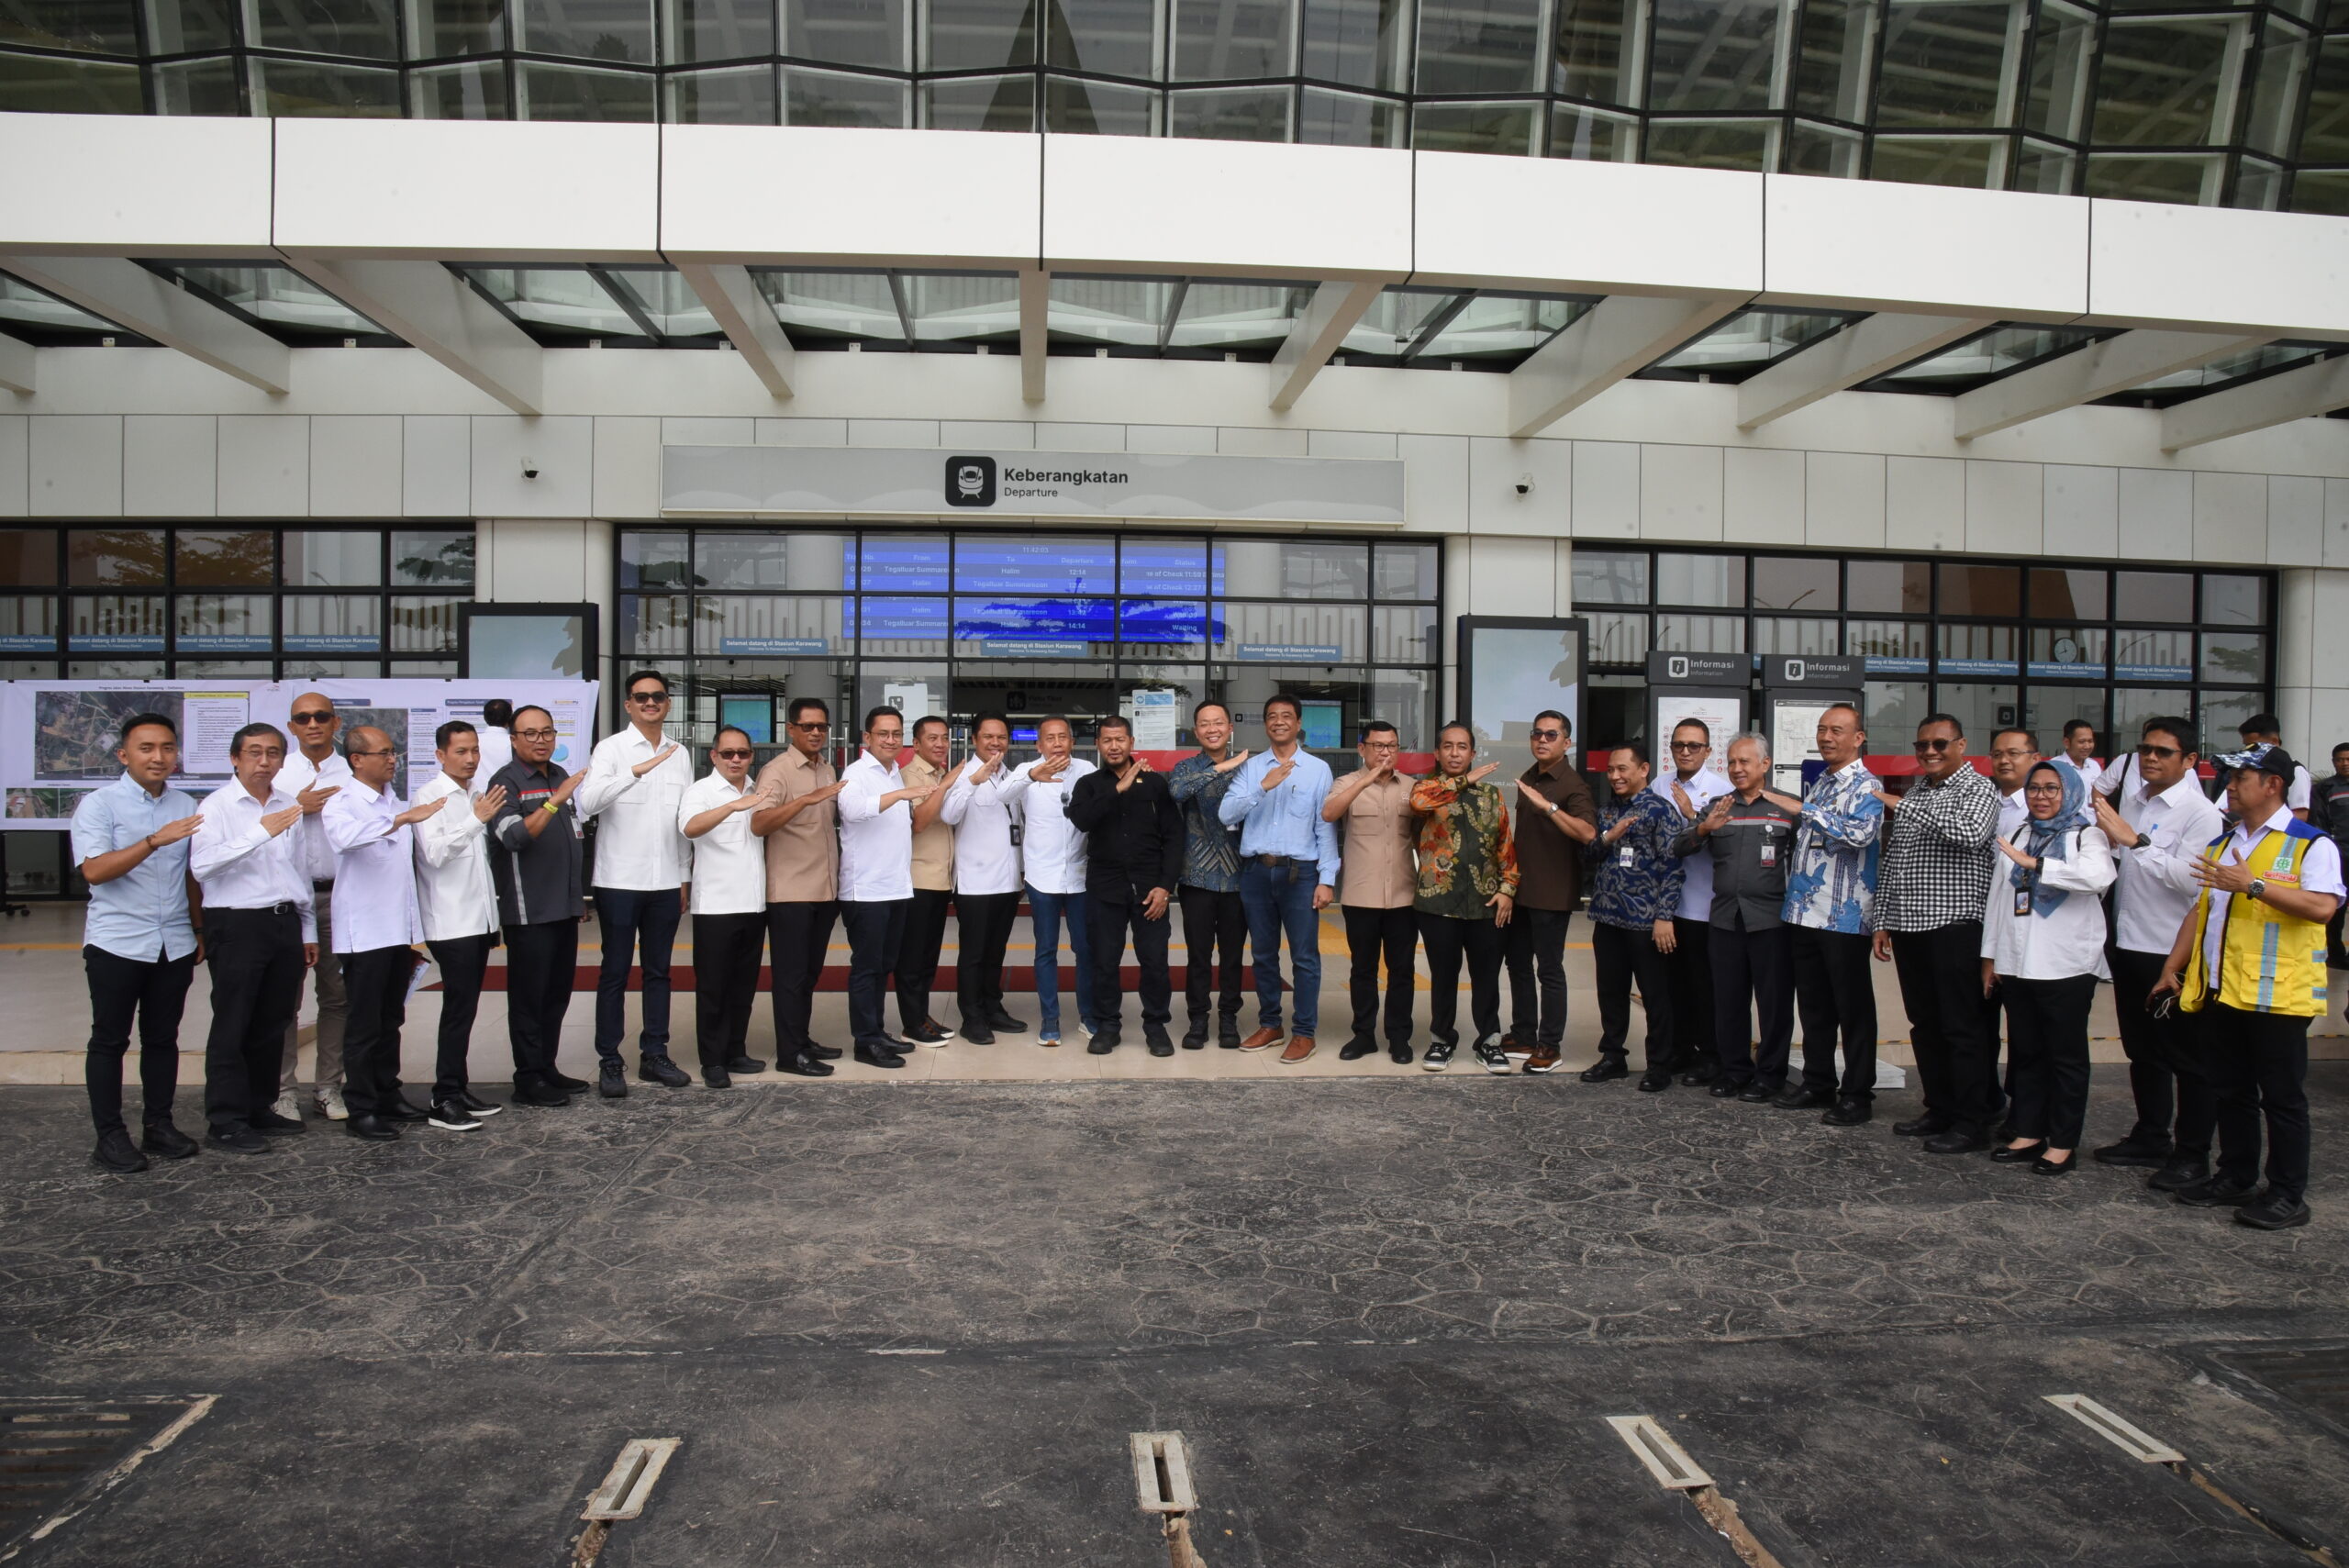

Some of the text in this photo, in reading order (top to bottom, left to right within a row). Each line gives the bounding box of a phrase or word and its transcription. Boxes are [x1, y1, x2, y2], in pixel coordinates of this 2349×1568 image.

[1004, 468, 1128, 485] Keberangkatan
[1004, 487, 1058, 499] Departure
[1691, 660, 1734, 669] Informasi
[1807, 663, 1850, 671] Informasi
